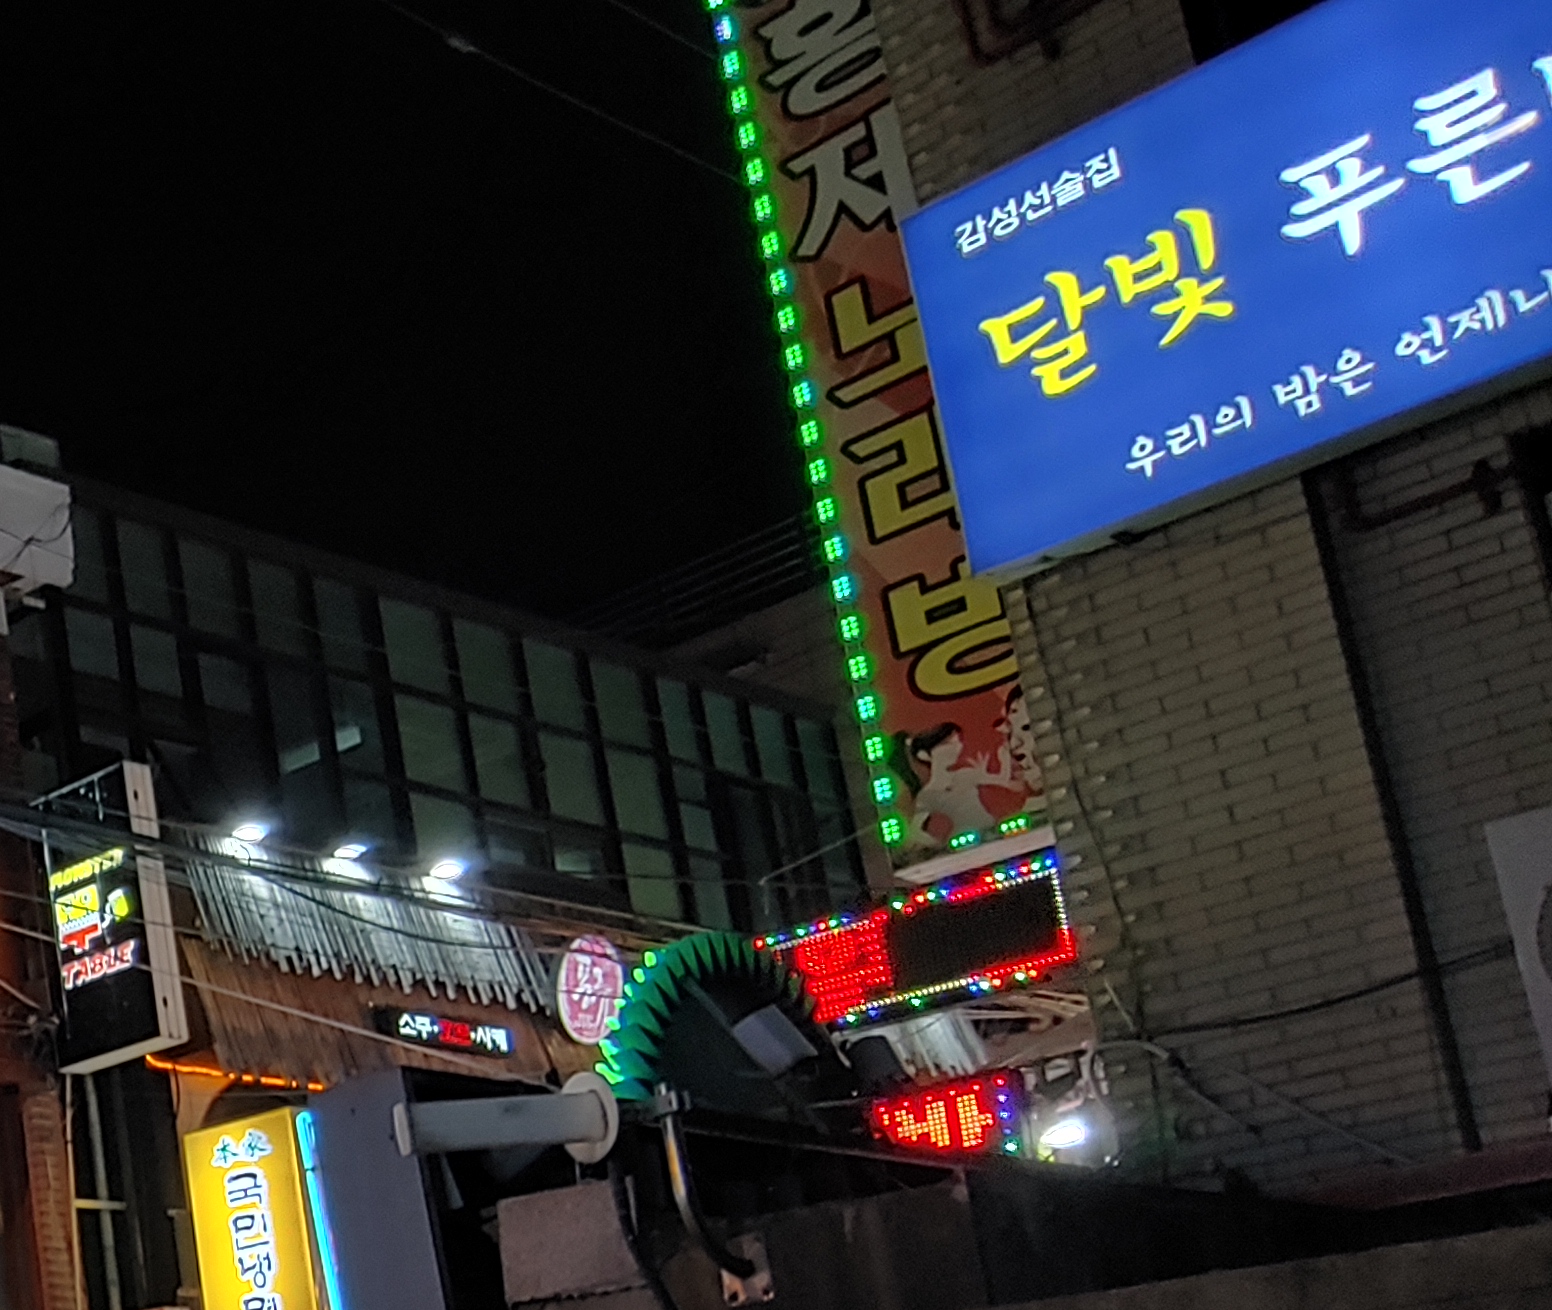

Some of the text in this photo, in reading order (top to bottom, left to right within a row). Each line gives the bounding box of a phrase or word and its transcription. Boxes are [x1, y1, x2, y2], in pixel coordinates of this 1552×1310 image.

[954, 147, 1121, 256] 감성선술집
[979, 52, 1552, 397] 달빛 푸른
[1124, 395, 1255, 478] 우리의
[1272, 347, 1376, 418] 밤은
[62, 939, 136, 990] TABLE
